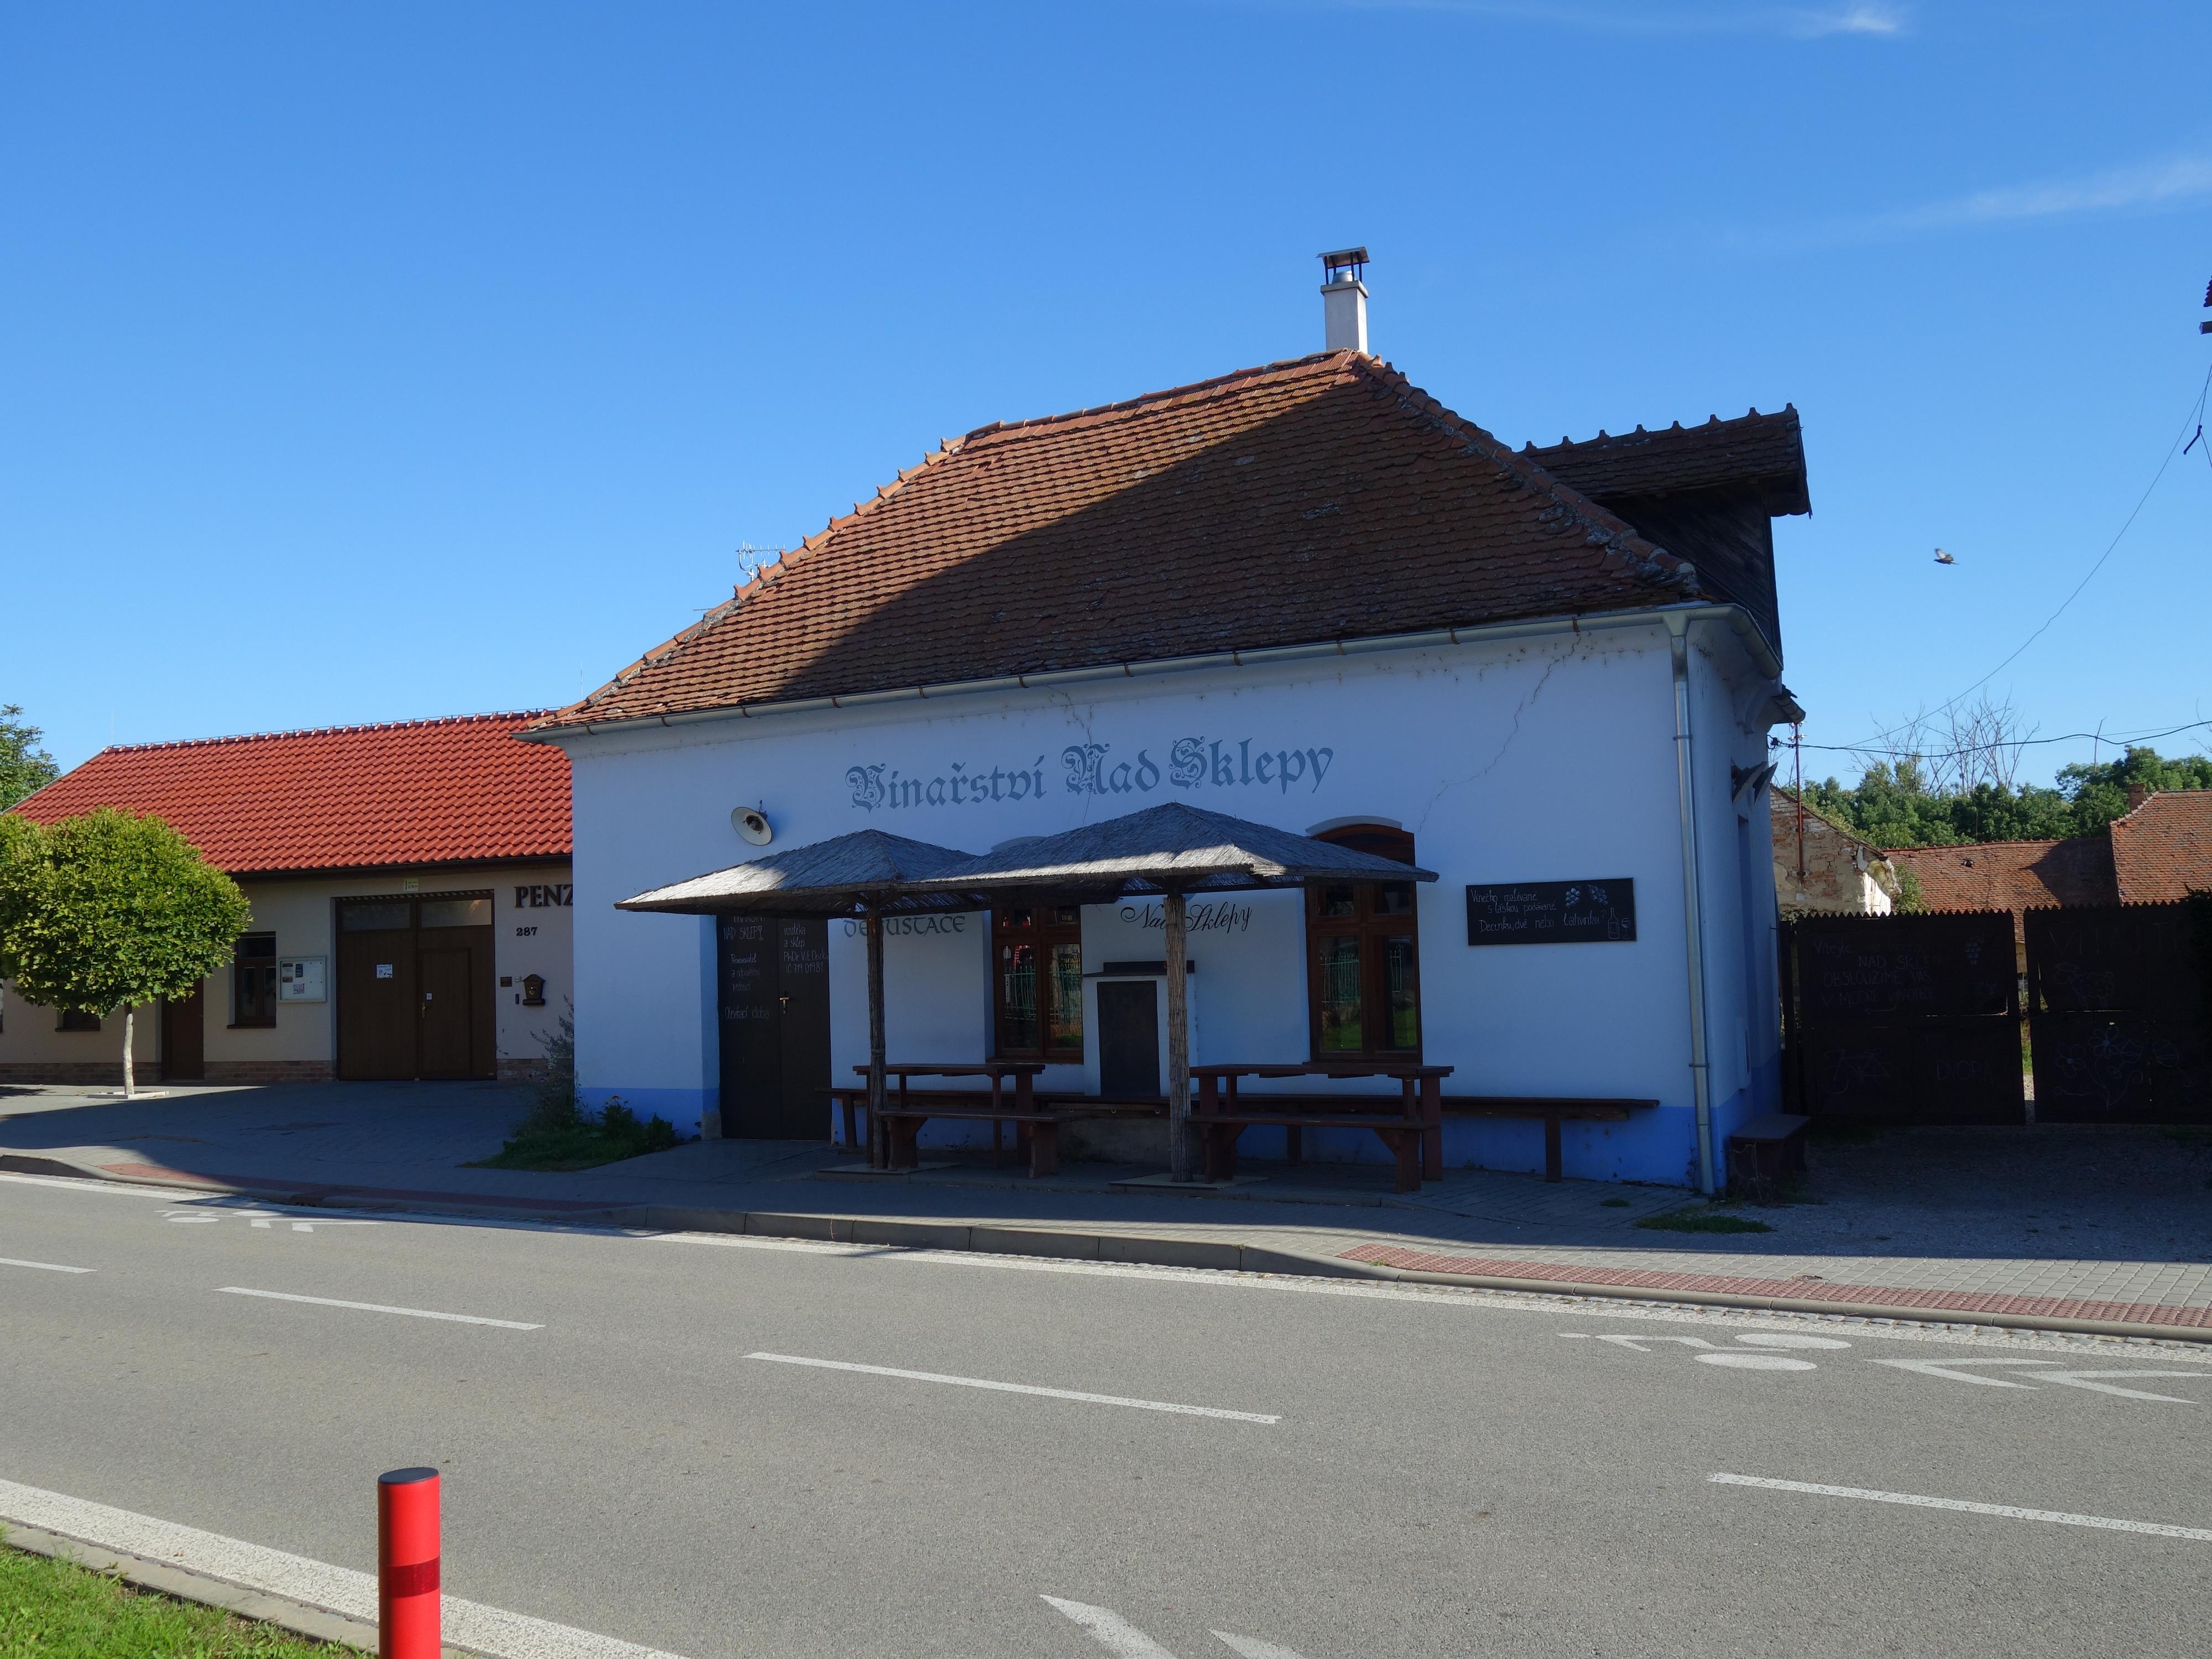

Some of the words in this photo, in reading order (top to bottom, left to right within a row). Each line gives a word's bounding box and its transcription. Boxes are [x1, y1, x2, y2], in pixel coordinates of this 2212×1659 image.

[846, 755, 1046, 813] Vinařství
[1061, 743, 1161, 795] Nad
[1168, 736, 1334, 795] Sklepy
[514, 884, 573, 908] PENZ
[1185, 901, 1252, 933] Sklepy
[1535, 914, 1555, 928] nebo
[516, 926, 538, 937] 287
[723, 926, 735, 941] NAD
[843, 915, 966, 938] DEUSTACE
[790, 936, 805, 950] sklep
[1858, 955, 1886, 969] NAD
[1820, 993, 1834, 1008] V
[752, 1005, 770, 1019] doba
